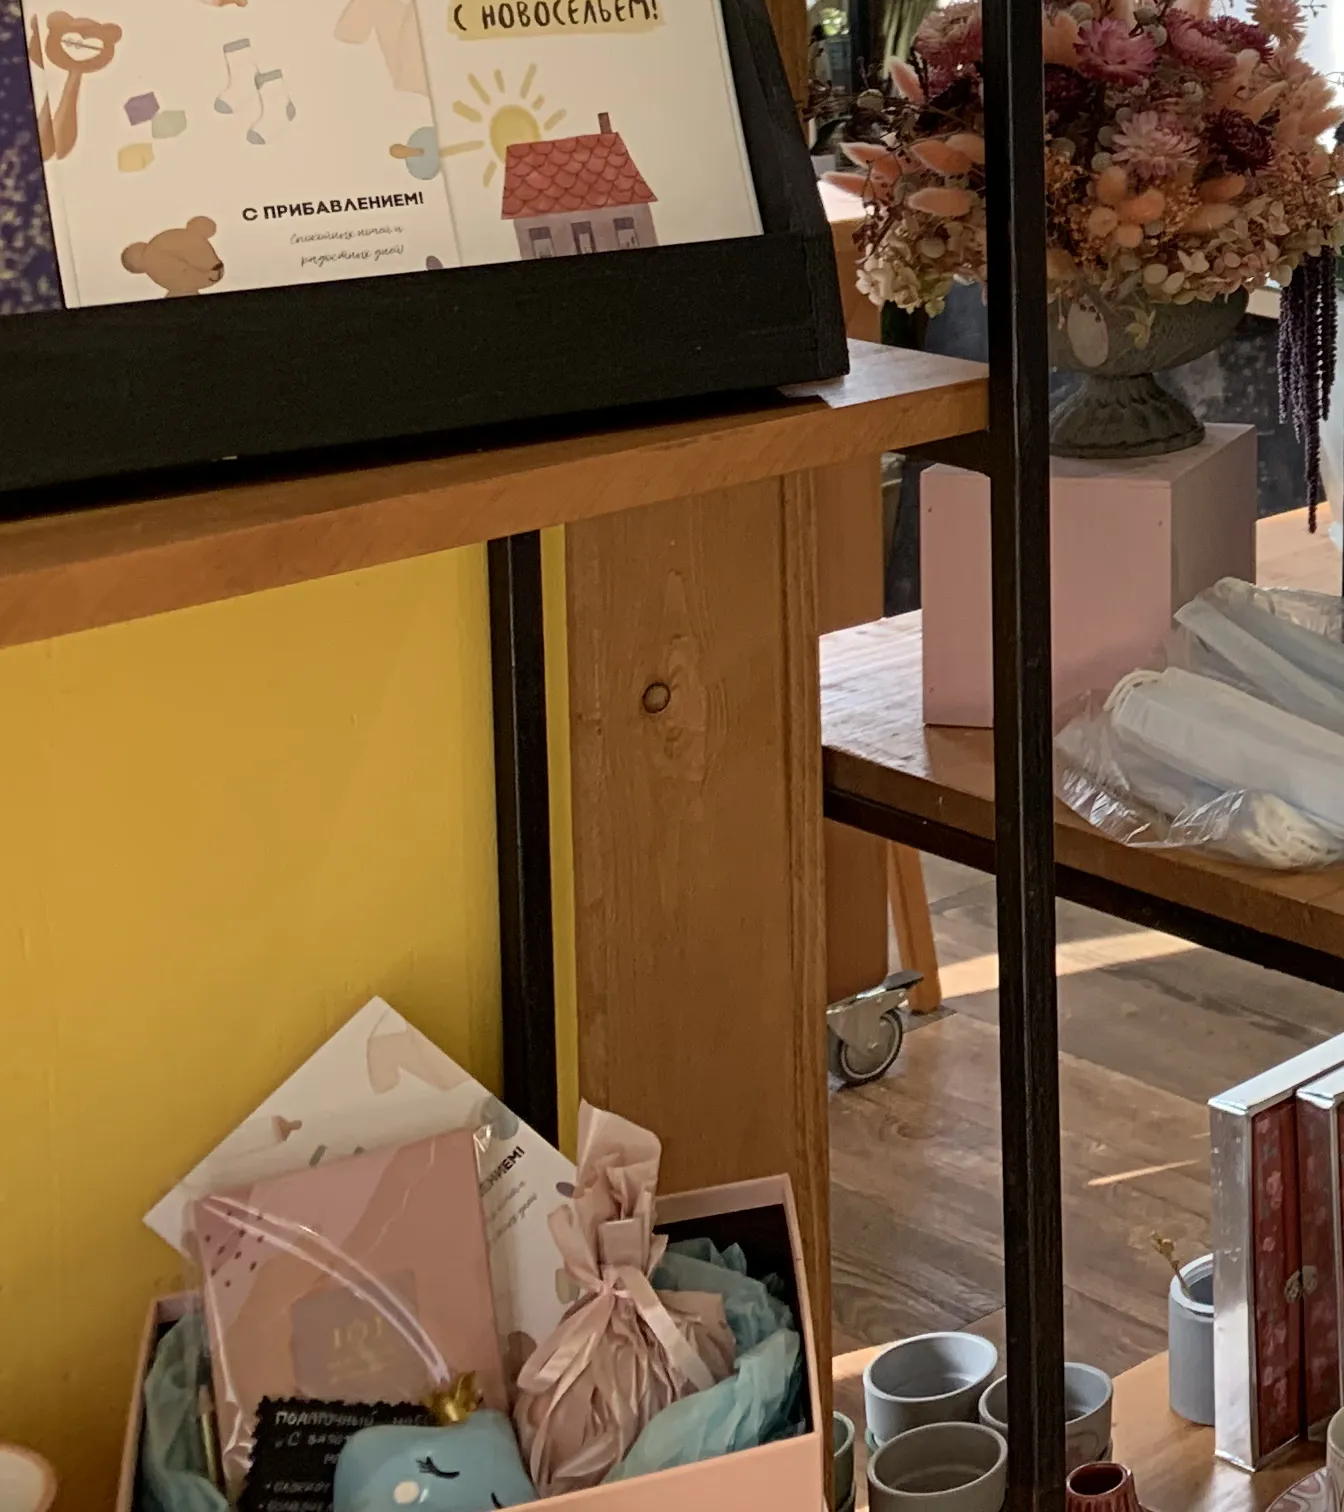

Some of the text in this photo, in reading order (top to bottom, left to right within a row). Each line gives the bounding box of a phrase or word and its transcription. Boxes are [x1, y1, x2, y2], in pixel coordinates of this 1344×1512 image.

[454, 4, 467, 31] С
[242, 191, 424, 222] С ПРИБАВЛЕНИЕМ!
